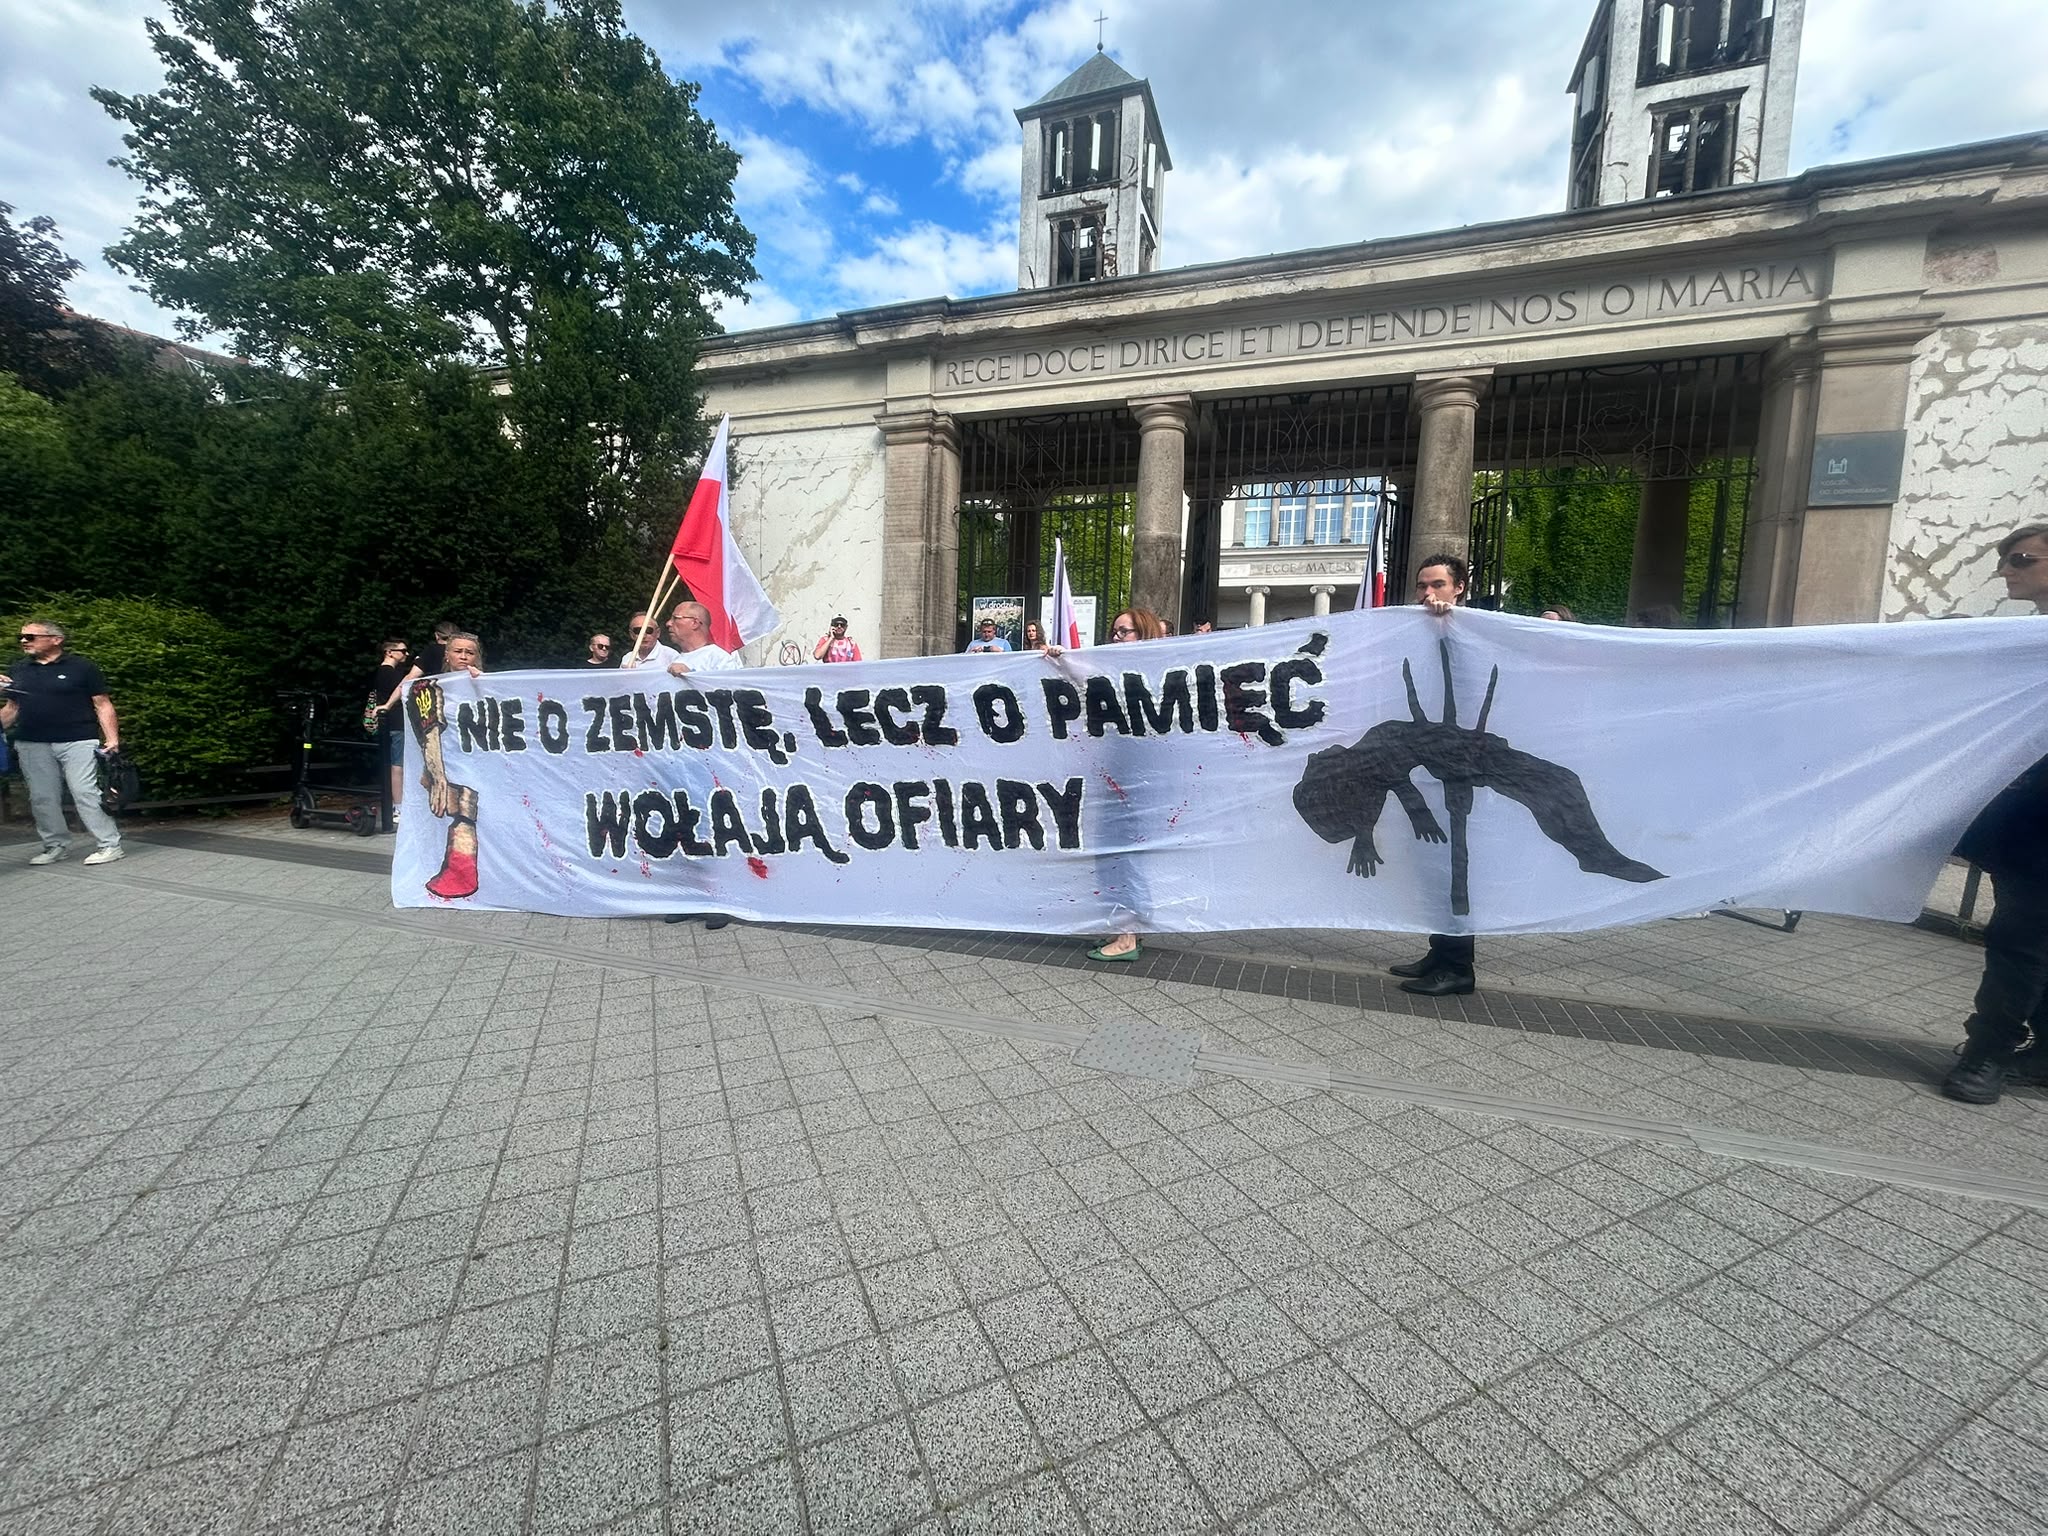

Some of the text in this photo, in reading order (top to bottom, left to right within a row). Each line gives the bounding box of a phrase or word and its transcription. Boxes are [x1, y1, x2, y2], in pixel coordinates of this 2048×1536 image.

[946, 264, 1814, 387] REGE DOCE DIRIGE ET DEFENDE NOS O MARIA
[456, 632, 1329, 765] NIE O ZEMSTĘ, LECZ O PAMIĘĆ
[585, 777, 1084, 864] WOŁAJĄ OFIARY
